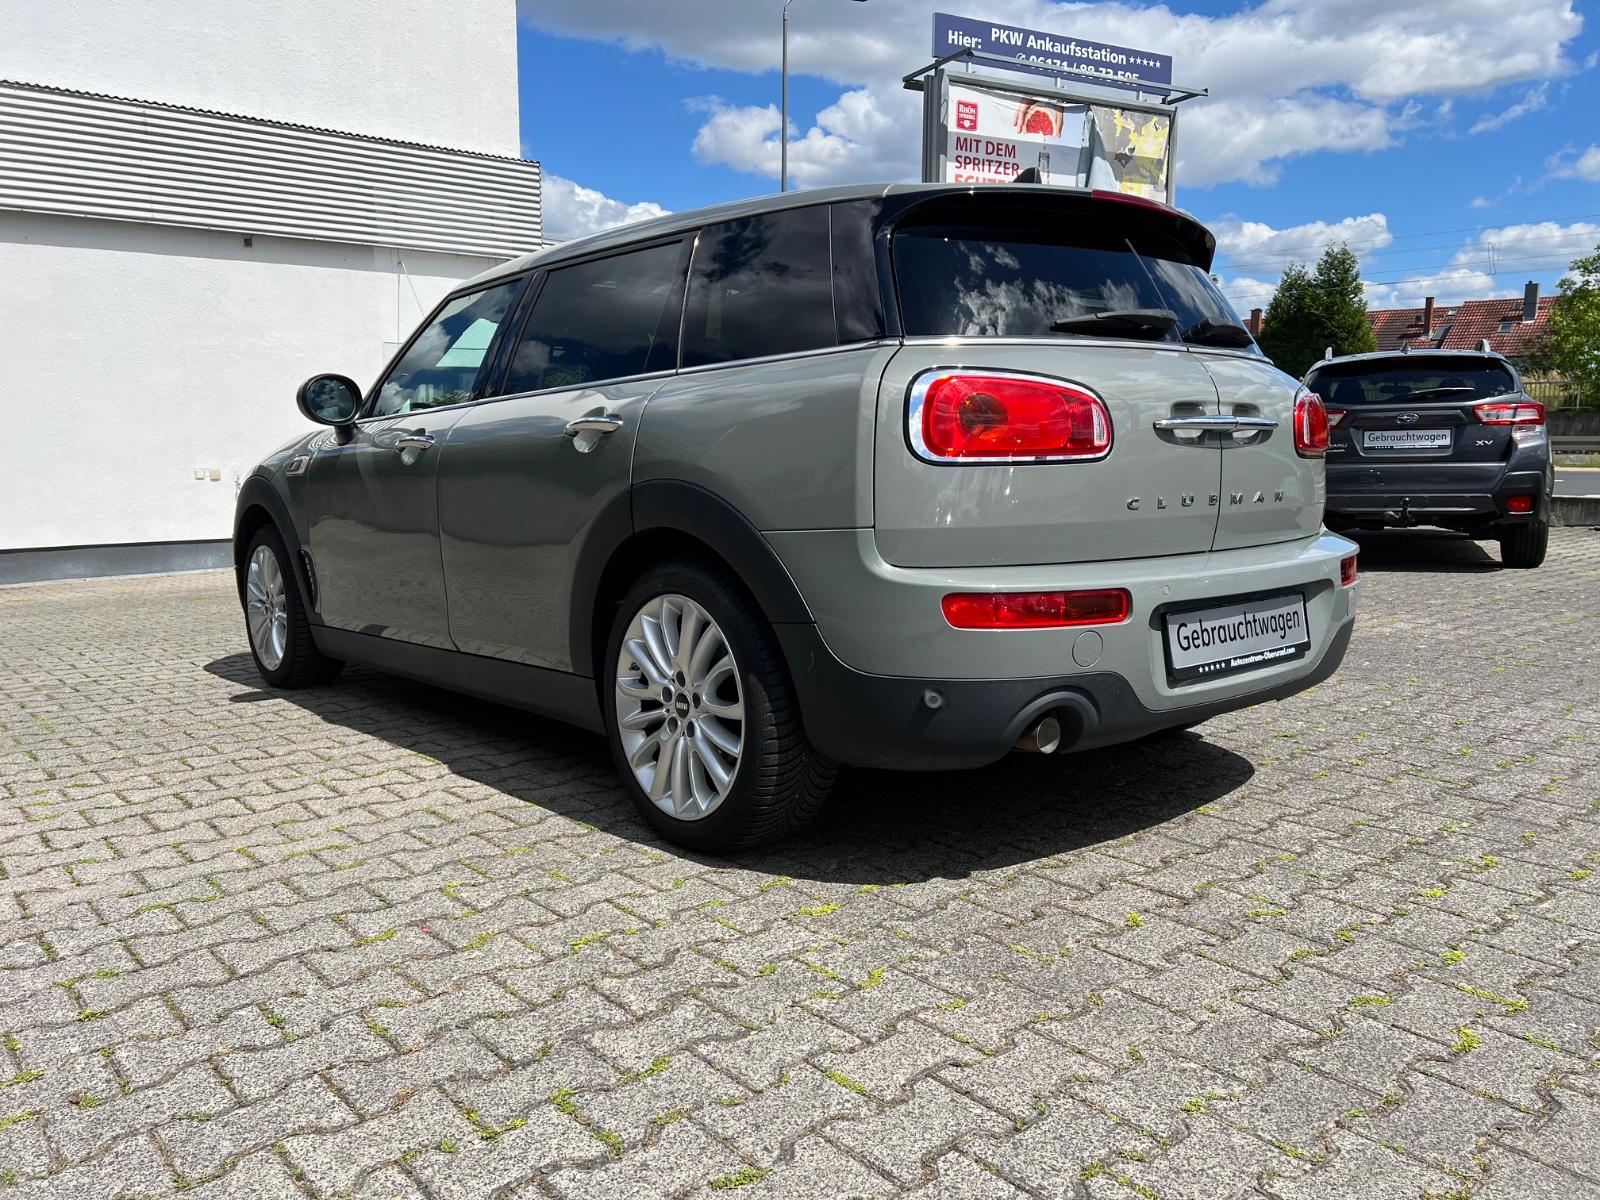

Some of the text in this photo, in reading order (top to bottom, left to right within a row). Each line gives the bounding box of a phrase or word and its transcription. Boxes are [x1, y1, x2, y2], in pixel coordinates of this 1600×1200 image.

[948, 27, 1127, 65] Hier: PKW Ankaufsstation
[955, 136, 1016, 158] MIT DEM
[954, 155, 1020, 176] SPRITZER
[1368, 432, 1447, 443] Gebrauchtwagen
[1126, 490, 1284, 511] CLUBMAN
[1176, 610, 1300, 651] Gebrauchtwagen
